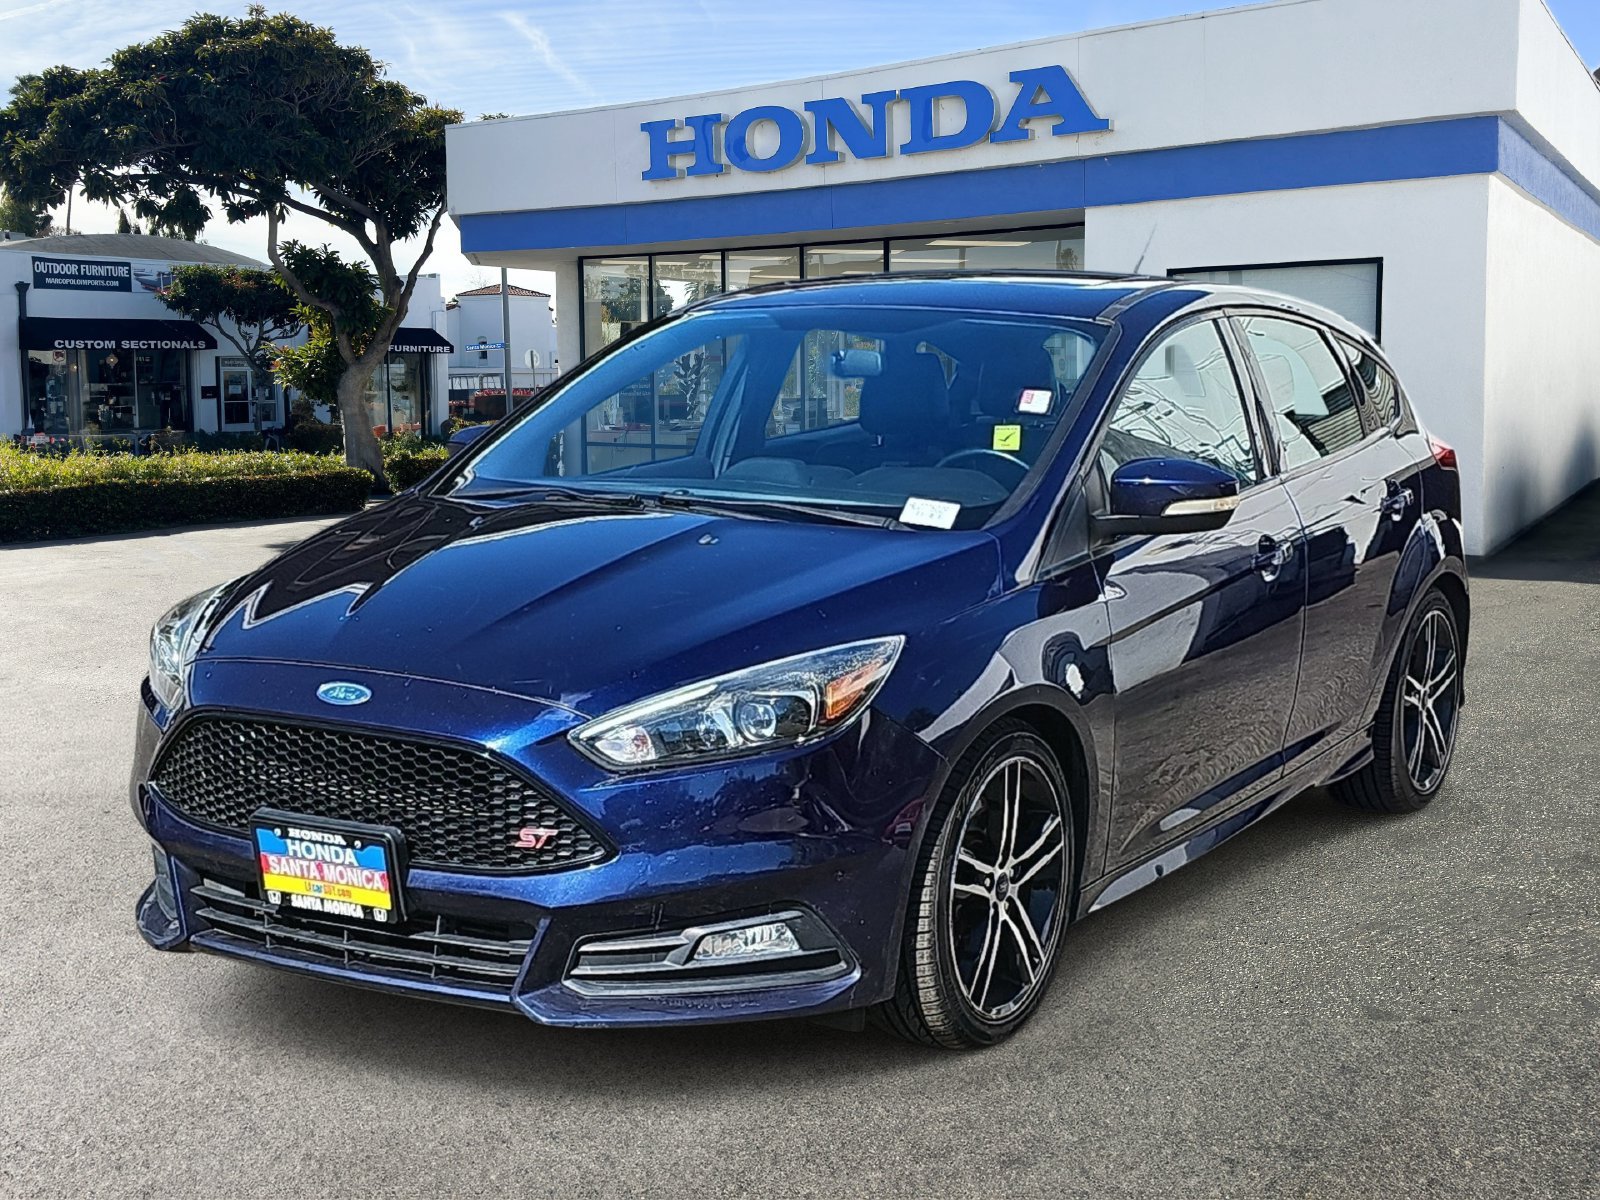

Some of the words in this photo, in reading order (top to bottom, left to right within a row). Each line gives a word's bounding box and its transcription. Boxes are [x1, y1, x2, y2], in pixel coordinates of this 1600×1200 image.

[640, 65, 1112, 181] HONDA
[34, 261, 79, 275] OUTDOOR
[80, 264, 130, 278] FURNITURE
[45, 277, 119, 287] MARCOPOLOIMPORTS.COM
[54, 339, 116, 349] CUSTOM
[121, 340, 206, 350] SECTIONALS
[388, 344, 451, 353] FURNITURE
[287, 827, 347, 846] HONDA
[515, 827, 559, 849] ST
[286, 838, 360, 867] HONDA
[268, 853, 321, 882] SANTA
[323, 862, 385, 891] MONICA
[290, 893, 323, 913] SANTA
[323, 898, 364, 920] MONICA
